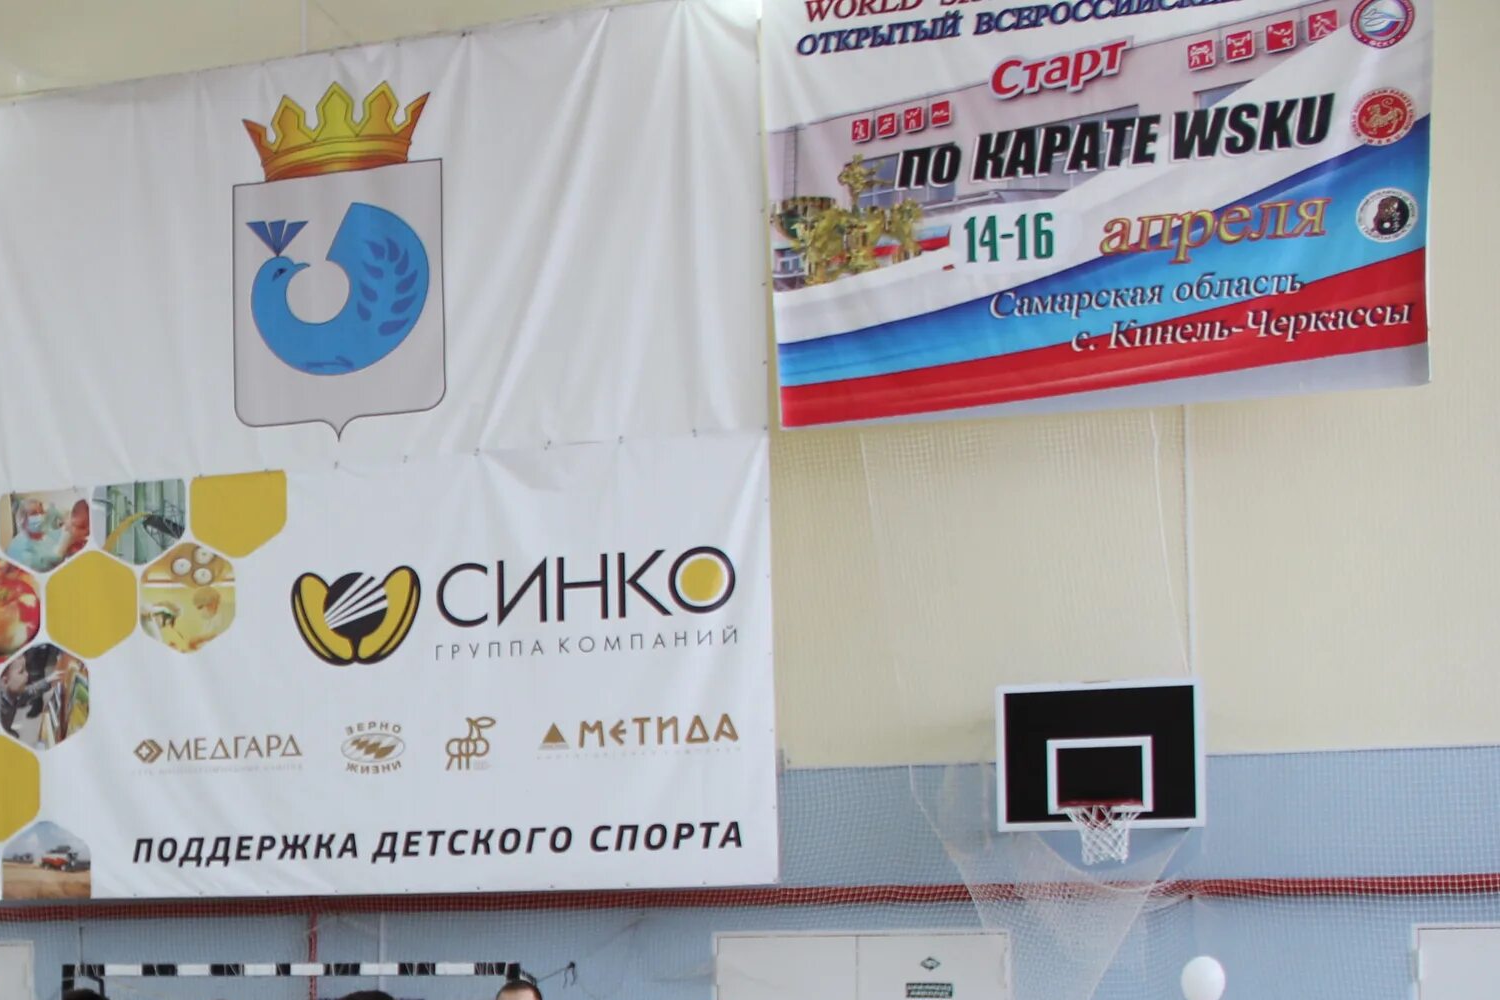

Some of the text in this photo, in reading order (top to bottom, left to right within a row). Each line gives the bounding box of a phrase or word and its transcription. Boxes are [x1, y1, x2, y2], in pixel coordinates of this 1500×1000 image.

[797, 0, 1240, 56] ОТКРЫТЫЙ ВСЕРОССИ
[991, 40, 1128, 95] Старт
[972, 114, 1161, 182] КАРАТЕ
[1171, 93, 1336, 161] WSKU
[964, 212, 1054, 264] 14-16
[1099, 197, 1333, 264] апреля
[989, 272, 1304, 320] Самарская область
[1070, 302, 1413, 352] с. Кинель-Черкассы
[436, 545, 737, 628] СИНКО
[435, 627, 740, 662] ГРУППА КОМПАНИЙ
[167, 734, 303, 762] МЕДГАРД
[345, 721, 403, 736] ЗЕРНО
[578, 713, 739, 749] МЕТИДА
[345, 760, 403, 775] ЖИЗНИ
[132, 821, 744, 866] ПОДДЕРЖКА ДЕТСКОГО СПОРТА
